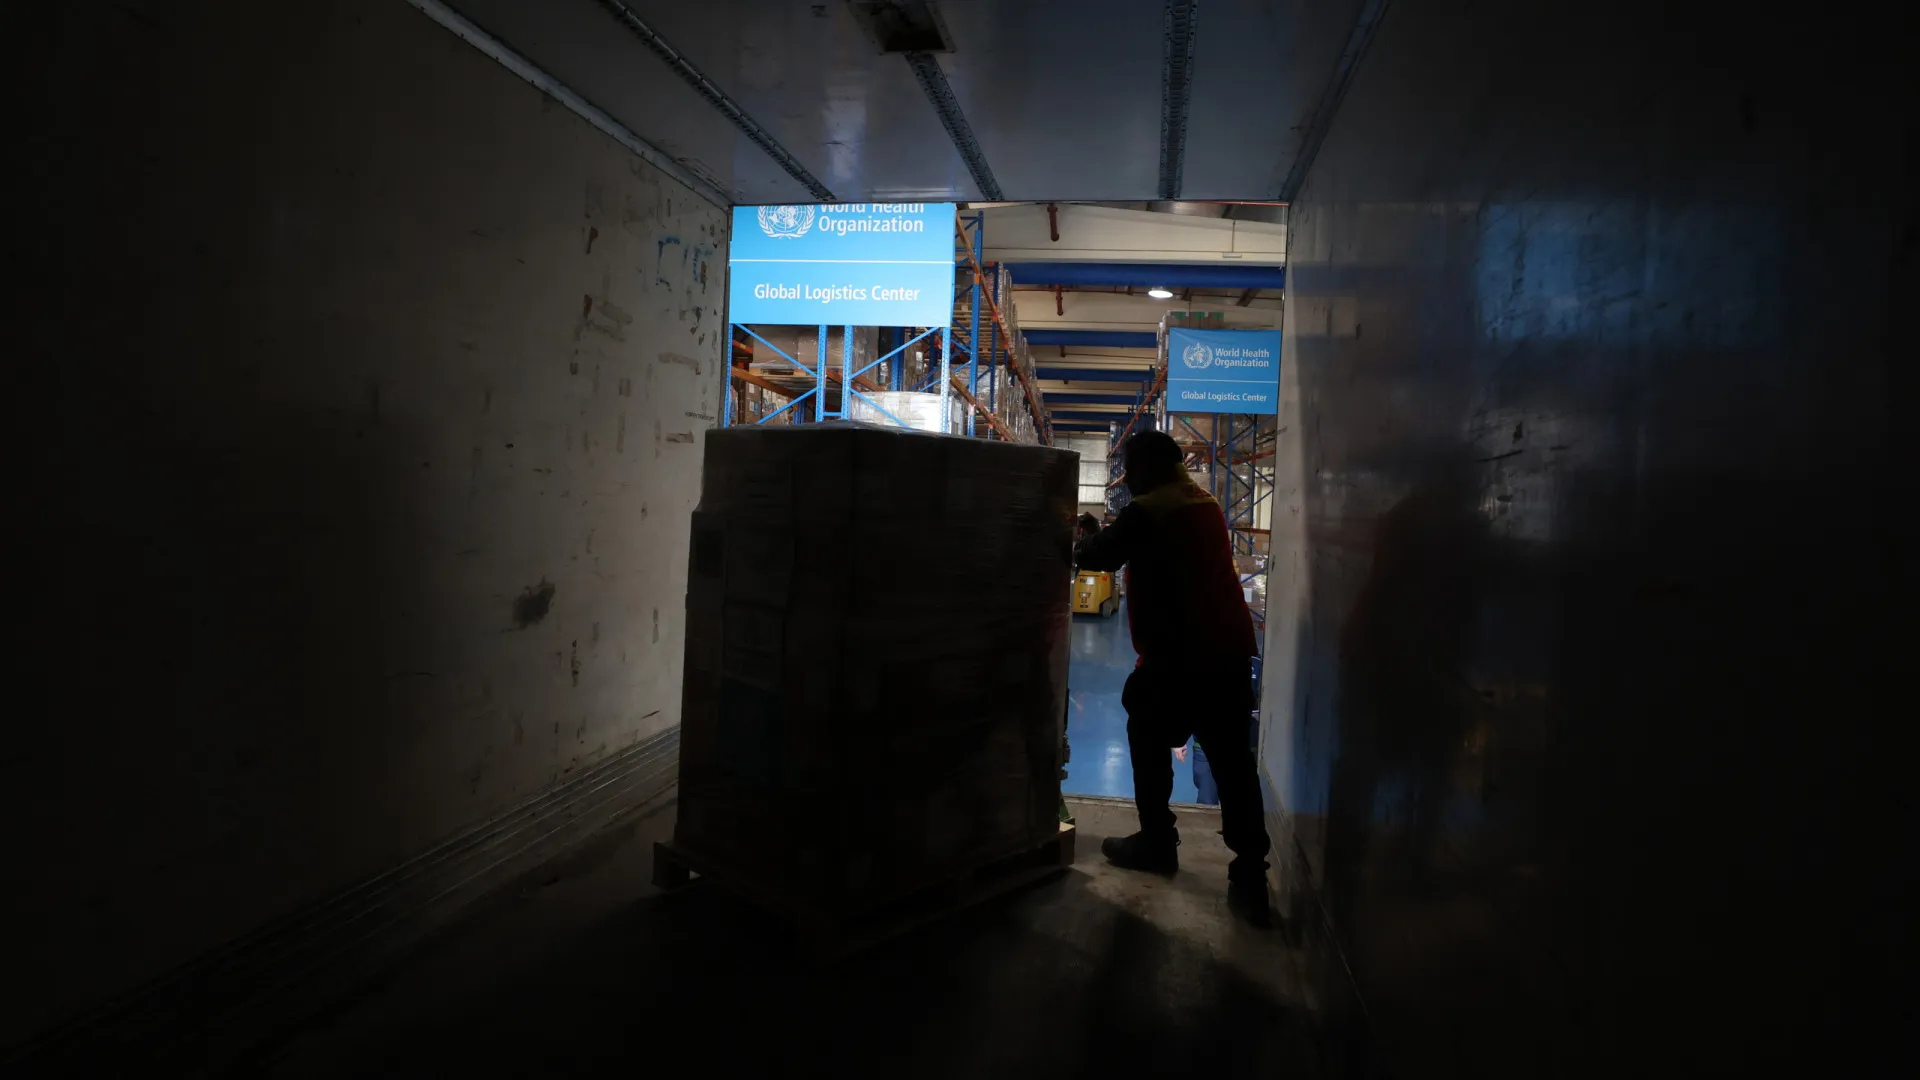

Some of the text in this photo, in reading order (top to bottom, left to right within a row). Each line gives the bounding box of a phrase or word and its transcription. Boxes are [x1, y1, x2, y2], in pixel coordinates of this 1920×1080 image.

[818, 216, 923, 236] Organization
[754, 284, 920, 303] Global Logistics Center
[1215, 348, 1269, 357] World Health
[1215, 357, 1269, 368] Organization
[1181, 391, 1267, 402] Global Logistics Center
